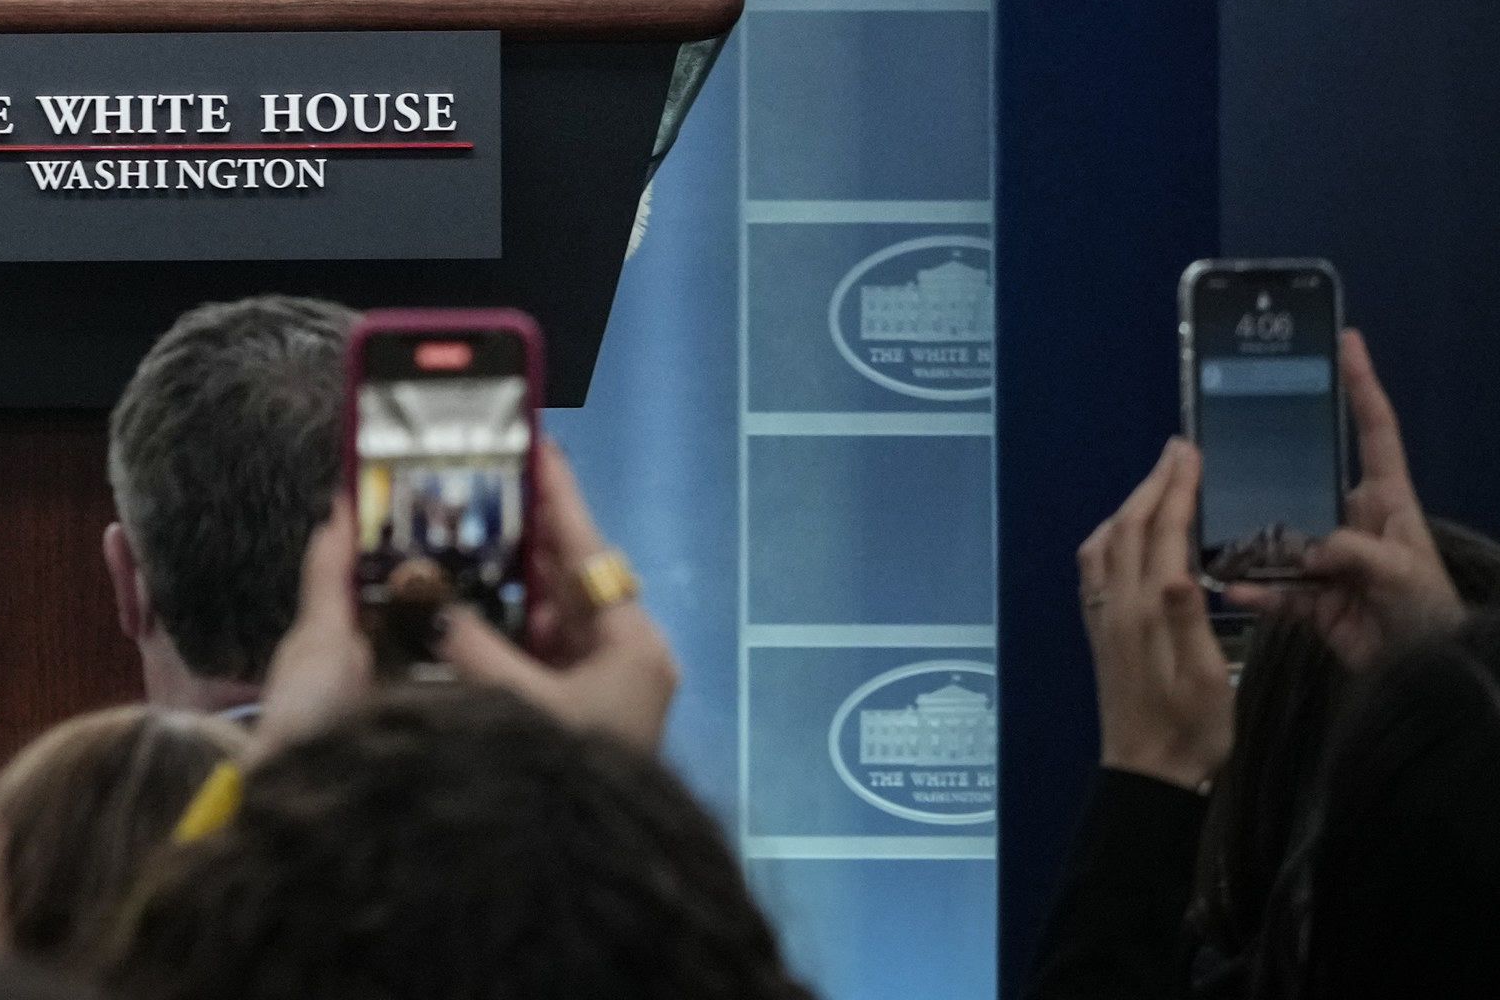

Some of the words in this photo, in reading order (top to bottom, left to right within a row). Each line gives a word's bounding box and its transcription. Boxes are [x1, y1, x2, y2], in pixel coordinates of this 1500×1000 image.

[35, 94, 231, 134] WHITE
[260, 92, 457, 133] HOUSE
[26, 158, 328, 190] WASHINGTON
[869, 347, 904, 362] THE
[909, 347, 969, 362] WHITE
[869, 771, 904, 787] THE
[910, 771, 969, 787] WHITE
